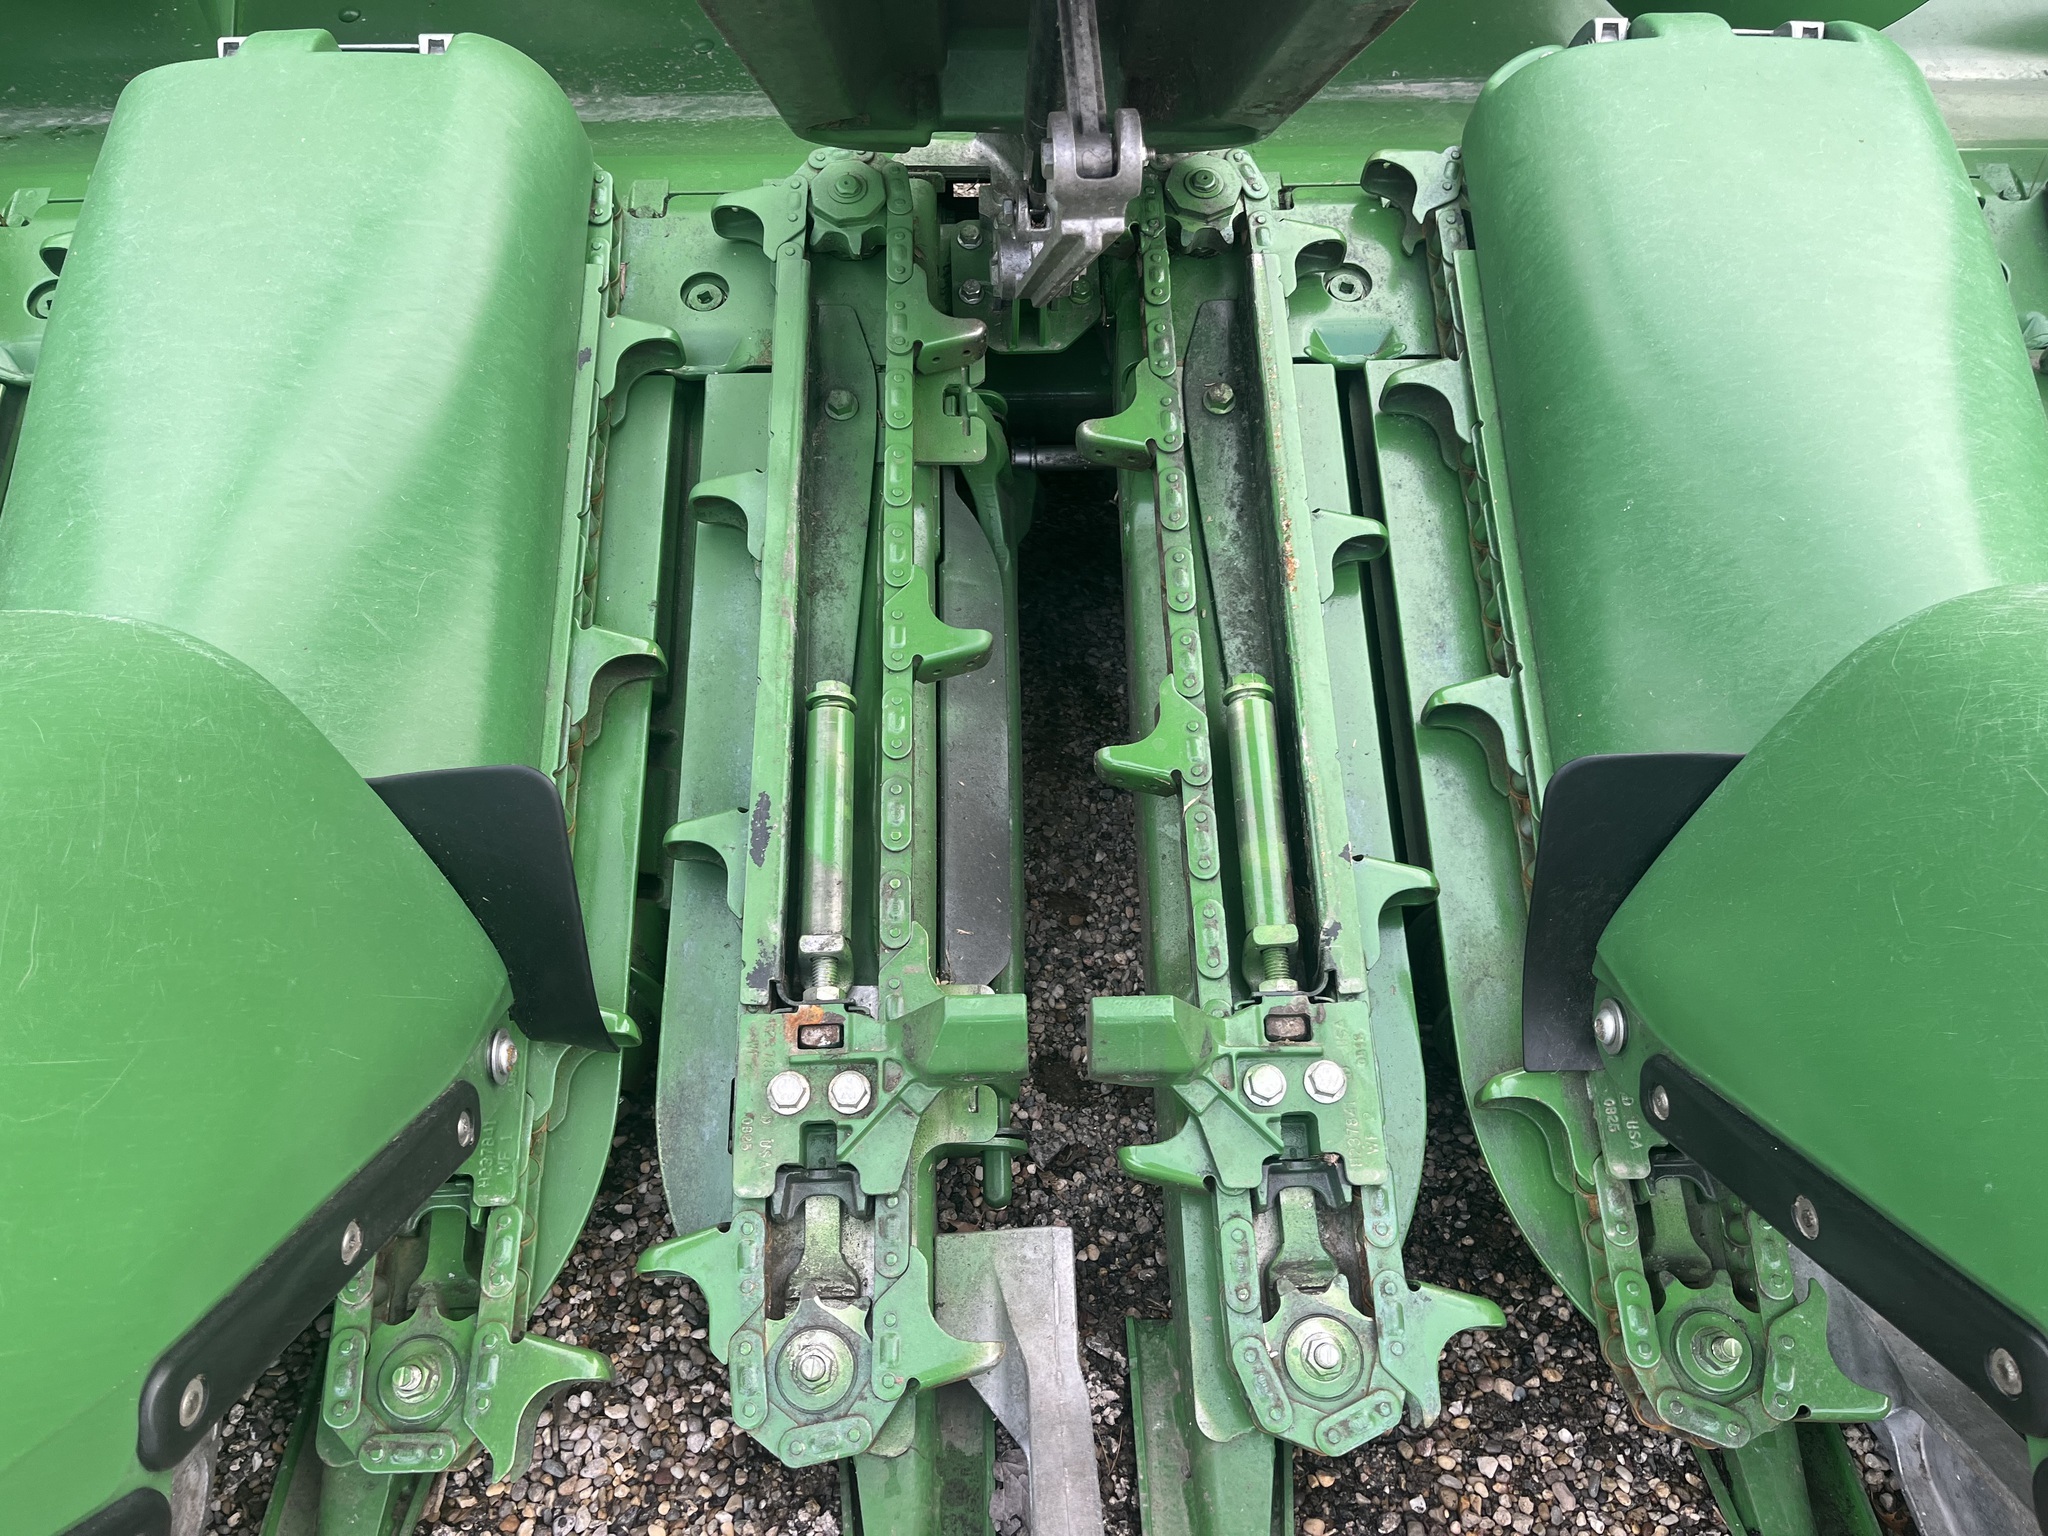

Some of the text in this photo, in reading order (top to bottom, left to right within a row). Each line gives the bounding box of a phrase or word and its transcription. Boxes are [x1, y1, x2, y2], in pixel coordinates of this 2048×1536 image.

[1603, 1099, 1620, 1133] 0825
[1626, 1121, 1643, 1150] USA
[759, 1140, 774, 1171] USA
